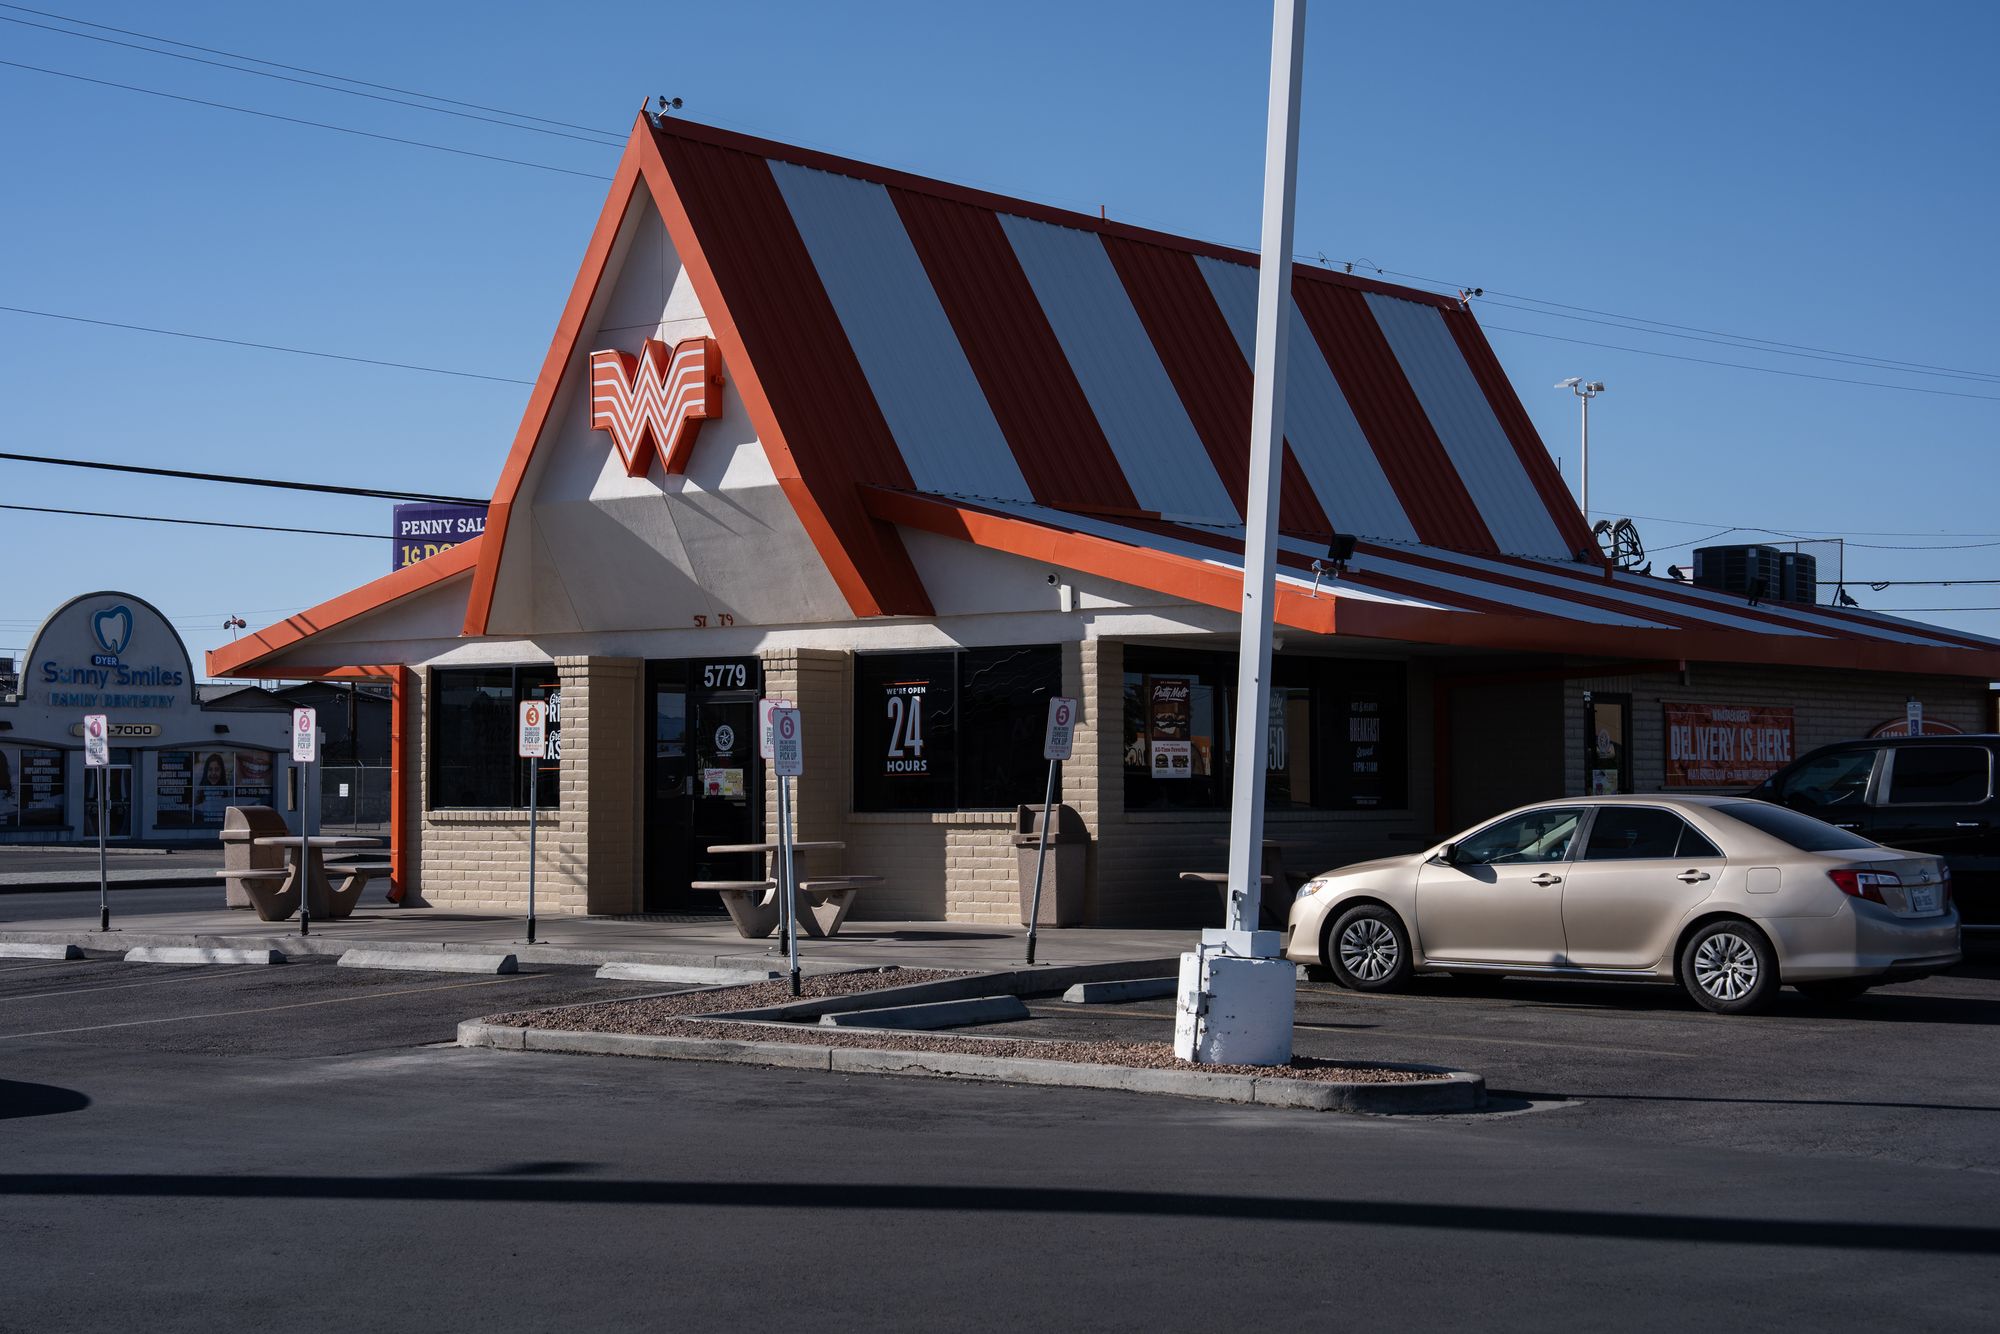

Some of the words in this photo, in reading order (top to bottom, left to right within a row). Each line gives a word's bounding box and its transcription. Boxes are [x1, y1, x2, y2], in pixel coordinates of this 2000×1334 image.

[589, 336, 707, 478] W
[401, 519, 453, 535] PENNY
[457, 517, 488, 533] SAL
[693, 615, 707, 627] 57
[718, 613, 734, 626] 79
[95, 655, 118, 666] DYER
[43, 661, 109, 689] Sunny
[116, 664, 184, 686] Smiles
[704, 664, 746, 688] 5779
[886, 687, 906, 695] WE'RE
[907, 686, 927, 694] OPEN
[50, 692, 98, 707] FAMILY
[102, 693, 175, 709] DENTISTRY
[530, 709, 537, 724] 3
[545, 704, 561, 723] PRI
[1058, 707, 1067, 722] 5
[107, 725, 152, 736] -7000
[301, 716, 309, 731] 2
[783, 719, 791, 736] 6
[887, 695, 924, 757] 24
[1349, 717, 1380, 742] BREAKFAST
[544, 741, 561, 760] TAS
[1268, 726, 1285, 771] 50
[1670, 725, 1735, 761] DELIVERY
[1740, 728, 1754, 761] IS
[1757, 728, 1791, 762] HERE
[780, 752, 790, 760] PICK
[887, 760, 928, 772] HOURS
